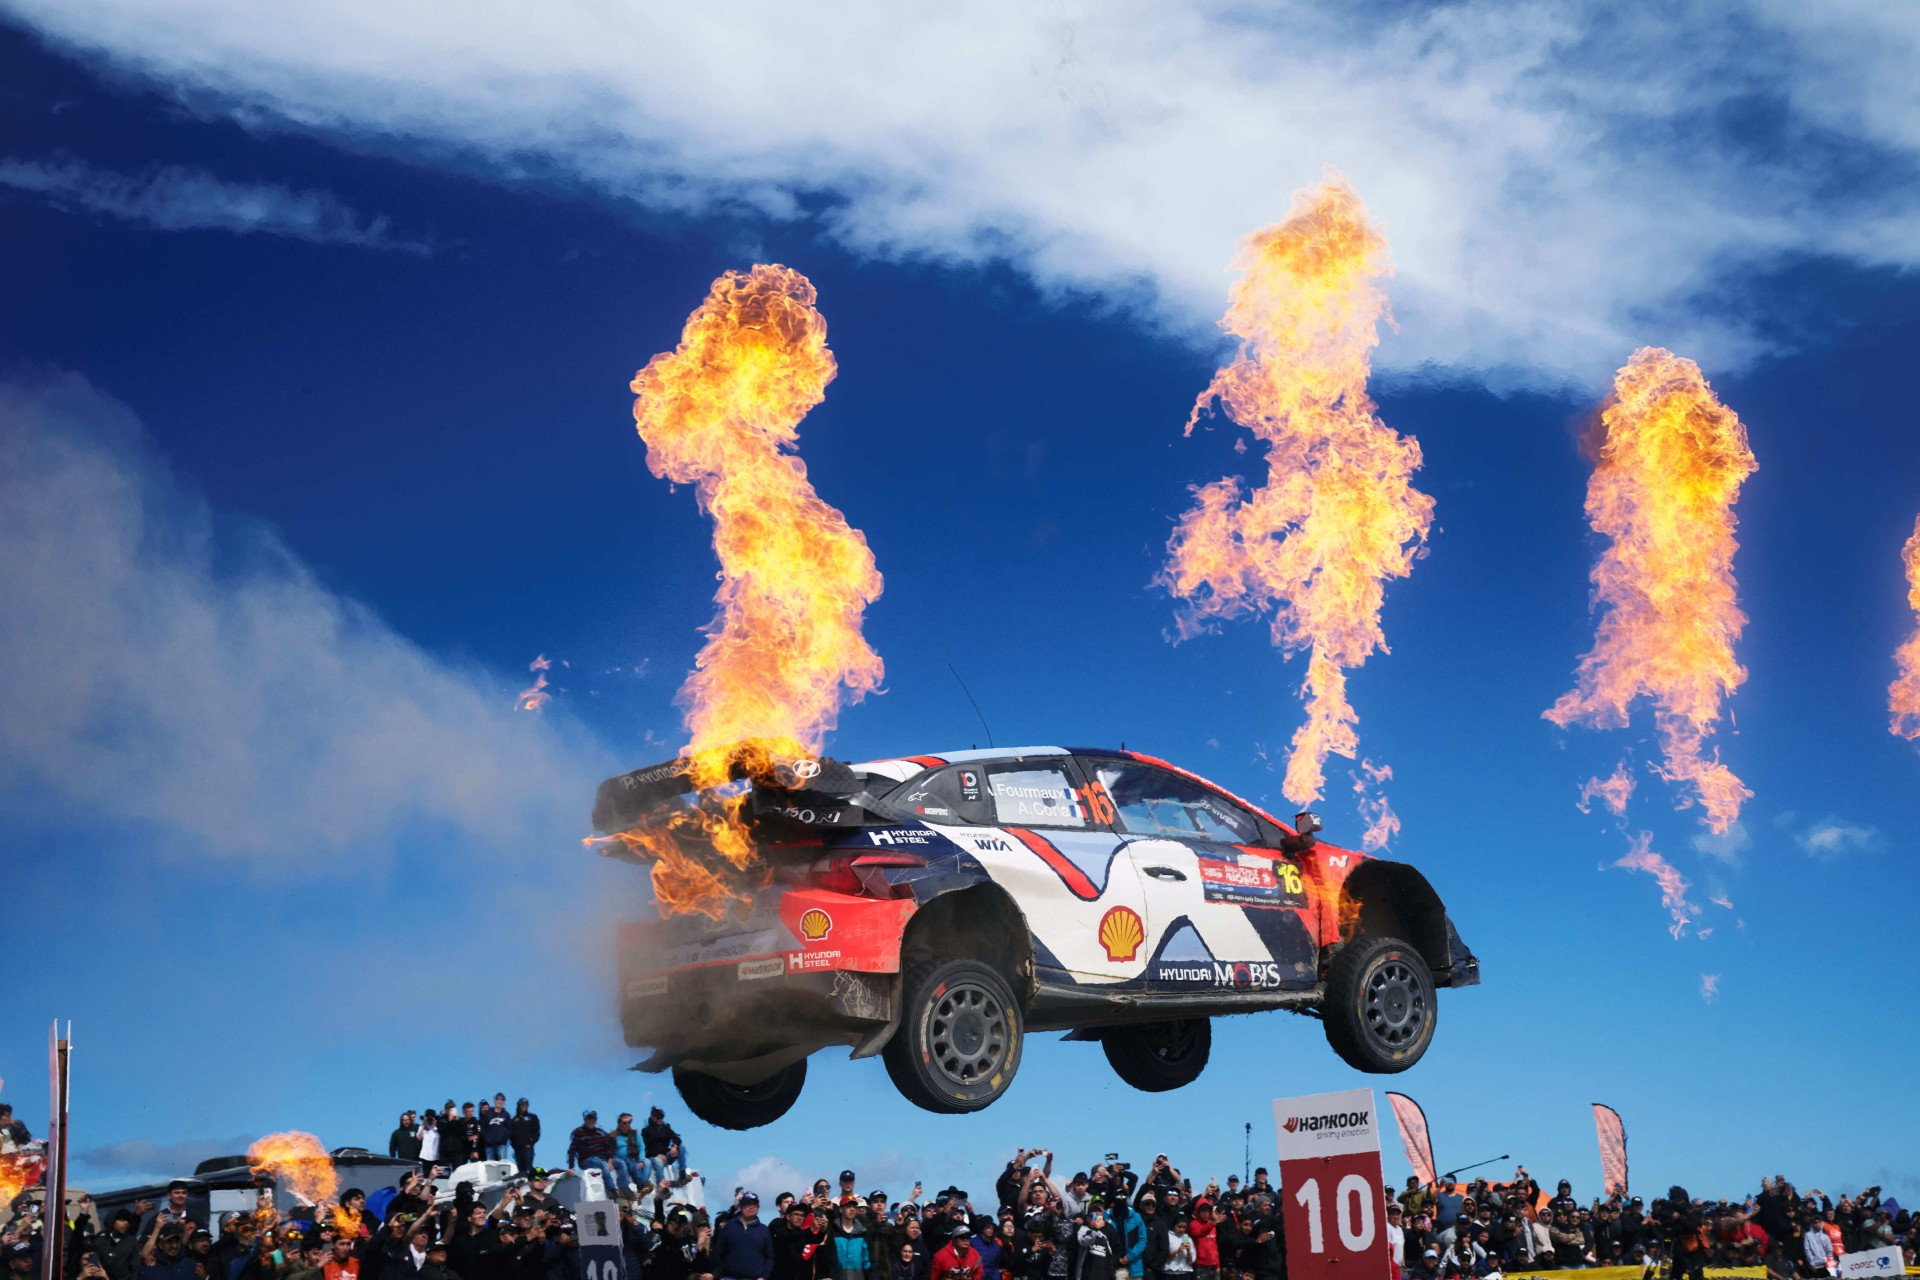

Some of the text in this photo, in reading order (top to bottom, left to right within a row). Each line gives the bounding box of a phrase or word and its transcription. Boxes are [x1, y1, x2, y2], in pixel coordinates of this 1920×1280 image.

[1081, 780, 1113, 825] 16
[974, 838, 1014, 852] WIA
[1276, 863, 1303, 894] 16
[803, 950, 841, 960] HYUNDAI
[804, 959, 831, 968] STEEL
[1159, 968, 1212, 981] HYUNDAI
[1213, 961, 1281, 988] MOBIS
[1295, 1173, 1376, 1254] 10
